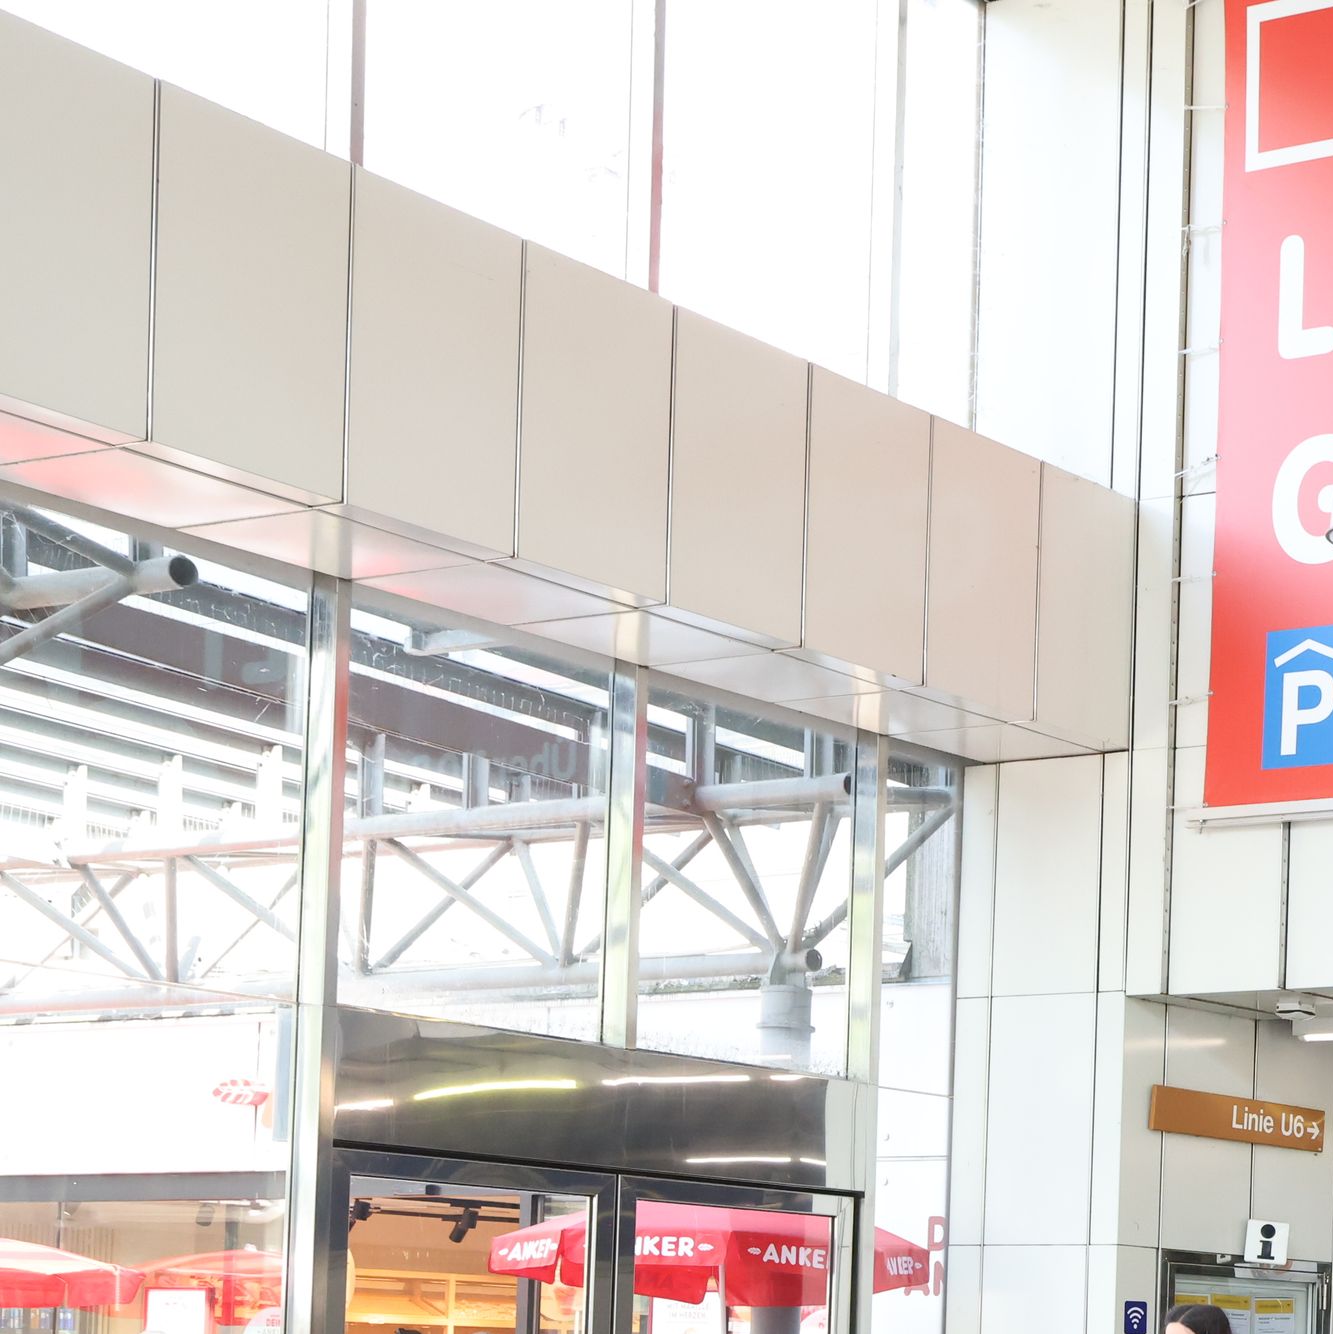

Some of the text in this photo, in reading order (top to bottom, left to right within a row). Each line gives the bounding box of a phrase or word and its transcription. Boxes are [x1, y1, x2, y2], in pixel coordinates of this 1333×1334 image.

[1232, 1105, 1304, 1138] Linie U6
[763, 1244, 829, 1270] ANKE
